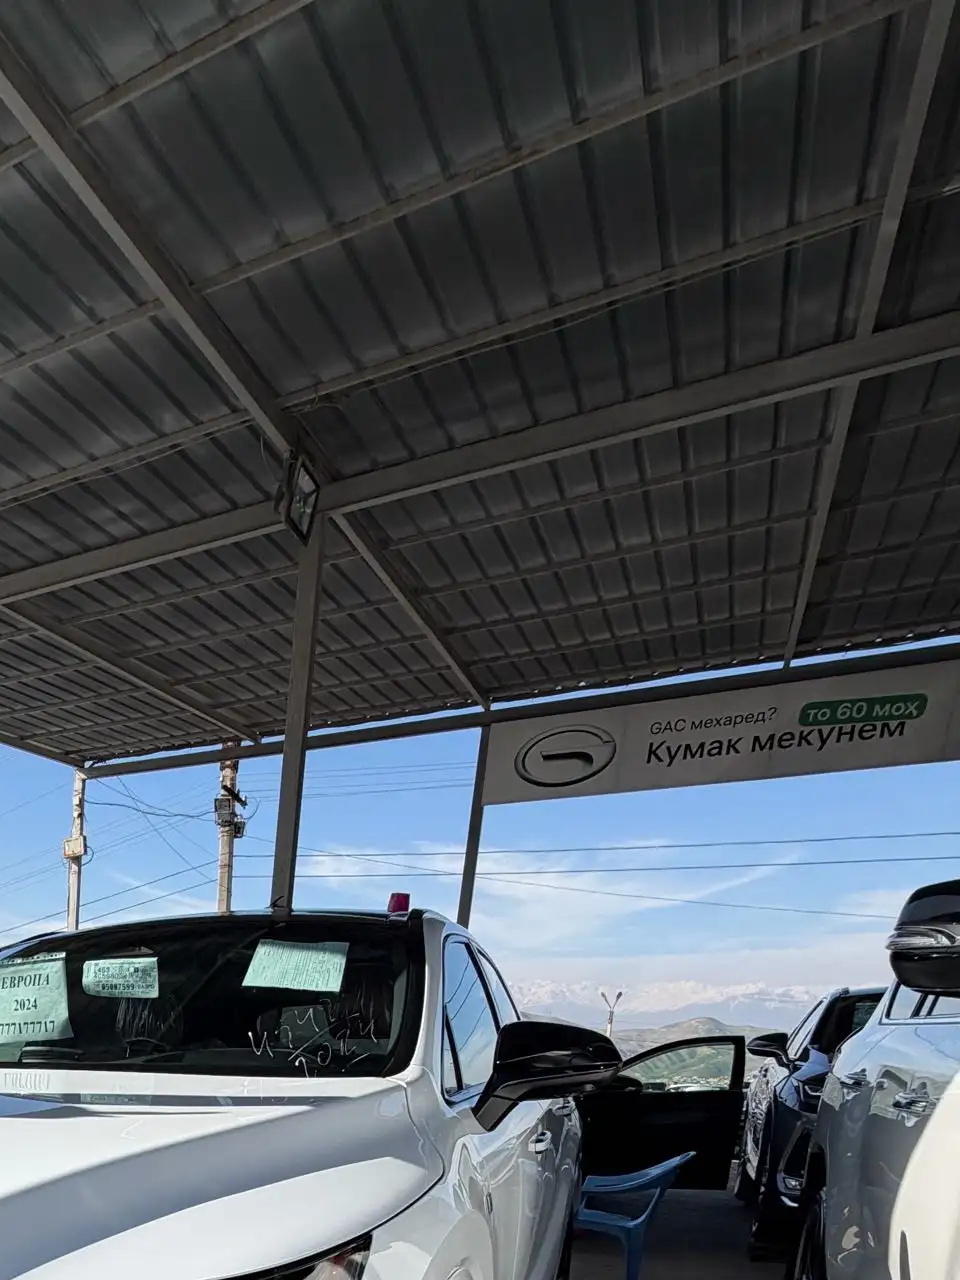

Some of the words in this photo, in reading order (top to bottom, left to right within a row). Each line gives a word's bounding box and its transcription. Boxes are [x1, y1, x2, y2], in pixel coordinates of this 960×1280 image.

[650, 718, 686, 734] GAC
[690, 706, 778, 731] мехаред?
[807, 708, 831, 722] то
[837, 702, 867, 719] 60
[646, 737, 743, 767] Кумак
[751, 720, 906, 752] мекунем
[1, 973, 50, 990] ЕВРОПА
[13, 997, 38, 1011] 2024
[0, 1020, 55, 1035] 777177717
